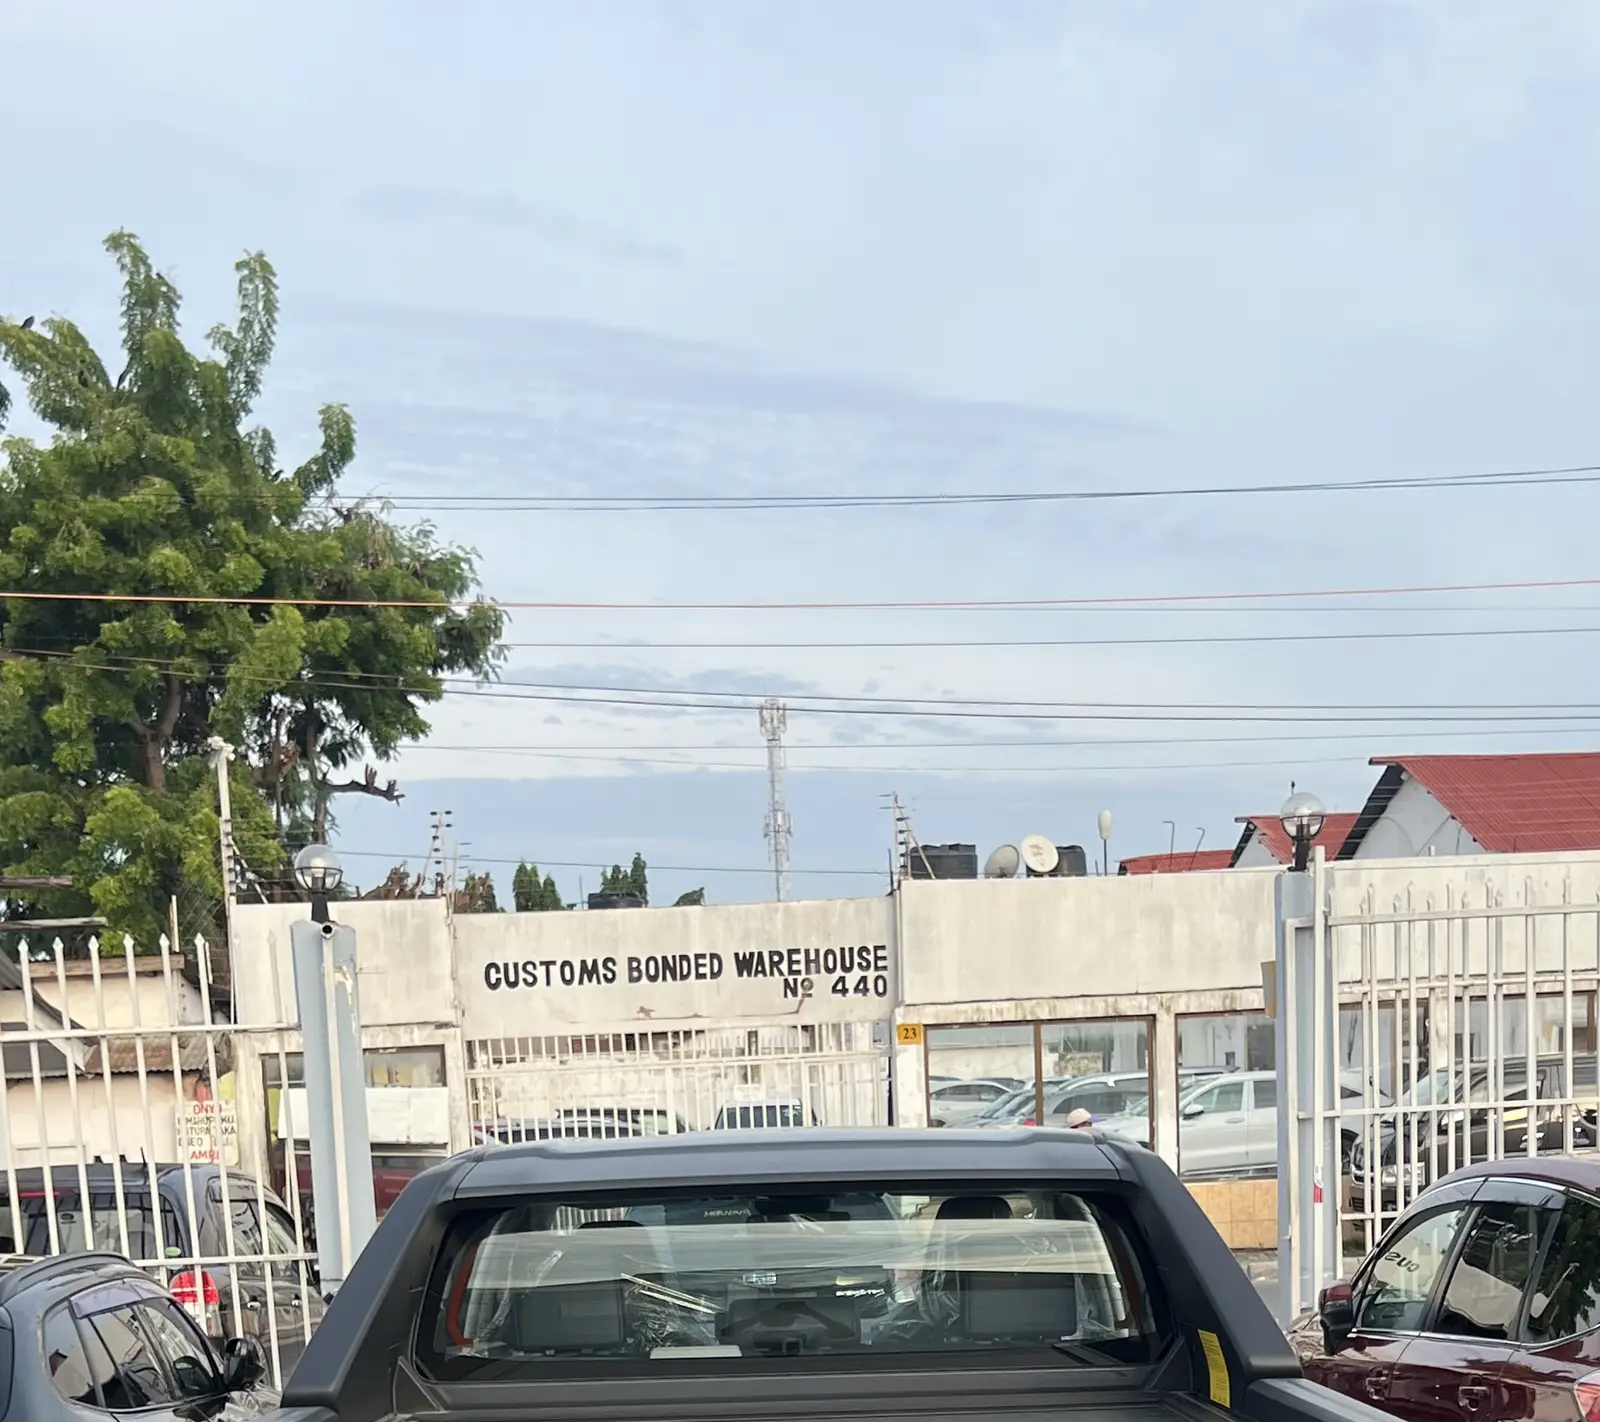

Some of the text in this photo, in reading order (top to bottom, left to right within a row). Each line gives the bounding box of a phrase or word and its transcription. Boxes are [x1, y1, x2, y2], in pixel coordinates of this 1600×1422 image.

[484, 945, 888, 991] CUSTOMS BONDED WAREHOUSE
[831, 974, 888, 998] 440
[903, 1027, 917, 1040] 23
